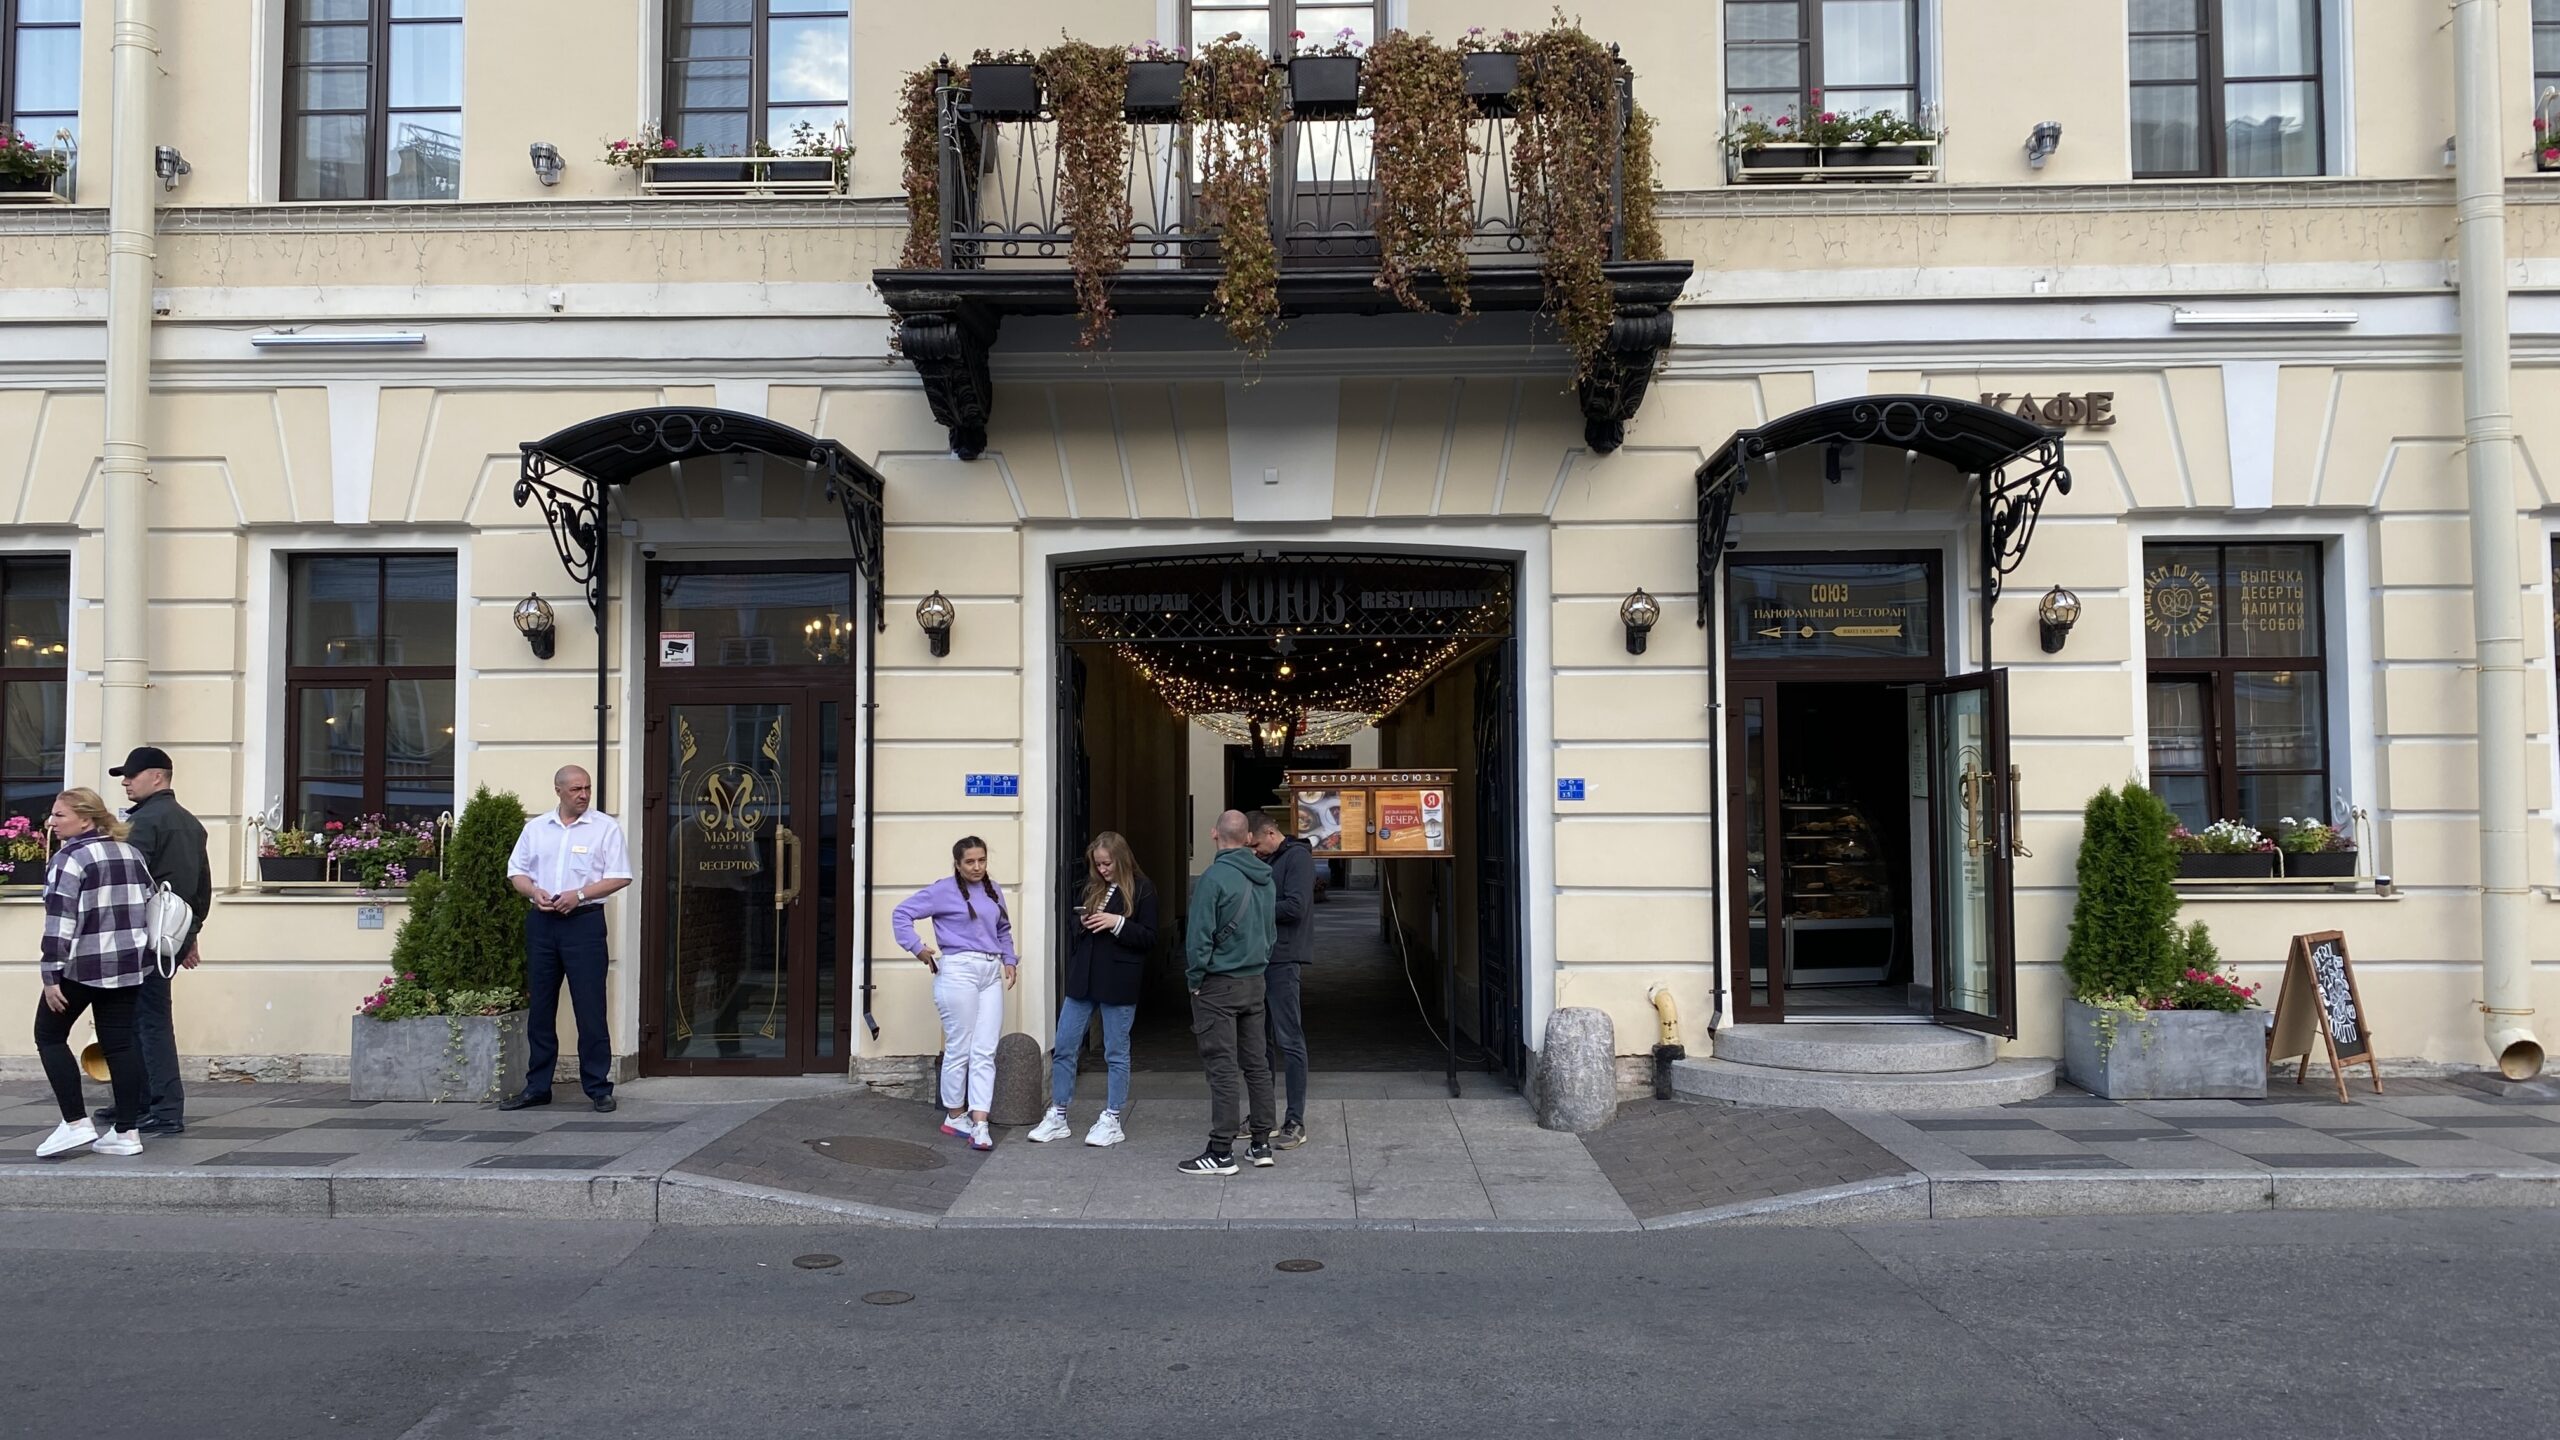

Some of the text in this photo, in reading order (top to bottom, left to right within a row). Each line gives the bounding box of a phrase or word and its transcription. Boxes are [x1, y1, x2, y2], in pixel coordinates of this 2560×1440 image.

[1980, 391, 2117, 425] КАФЕ
[2173, 563, 2187, 578] ПО
[2240, 569, 2304, 584] ВЫПЕЧКА
[1221, 567, 1345, 626] СОЮЗ
[1361, 591, 1493, 609] RESTAURANT
[1811, 583, 1849, 603] СОЮЗ
[2240, 585, 2304, 601] ДЕСЕРТЫ
[1083, 593, 1189, 612] РЕСТОРАН
[2241, 602, 2305, 615] НАПИТКИ
[1754, 606, 1906, 620] ПАНОРАМНЫЙ РЕСТОРАН
[2242, 617, 2305, 631] С СОБОЙ
[1301, 774, 1441, 782] РЕСТОРАН «СОЮЗ»
[1384, 815, 1420, 825] ВЕЧЕРА
[704, 830, 755, 843] МАРИЯ
[699, 860, 760, 871] RECEPTION
